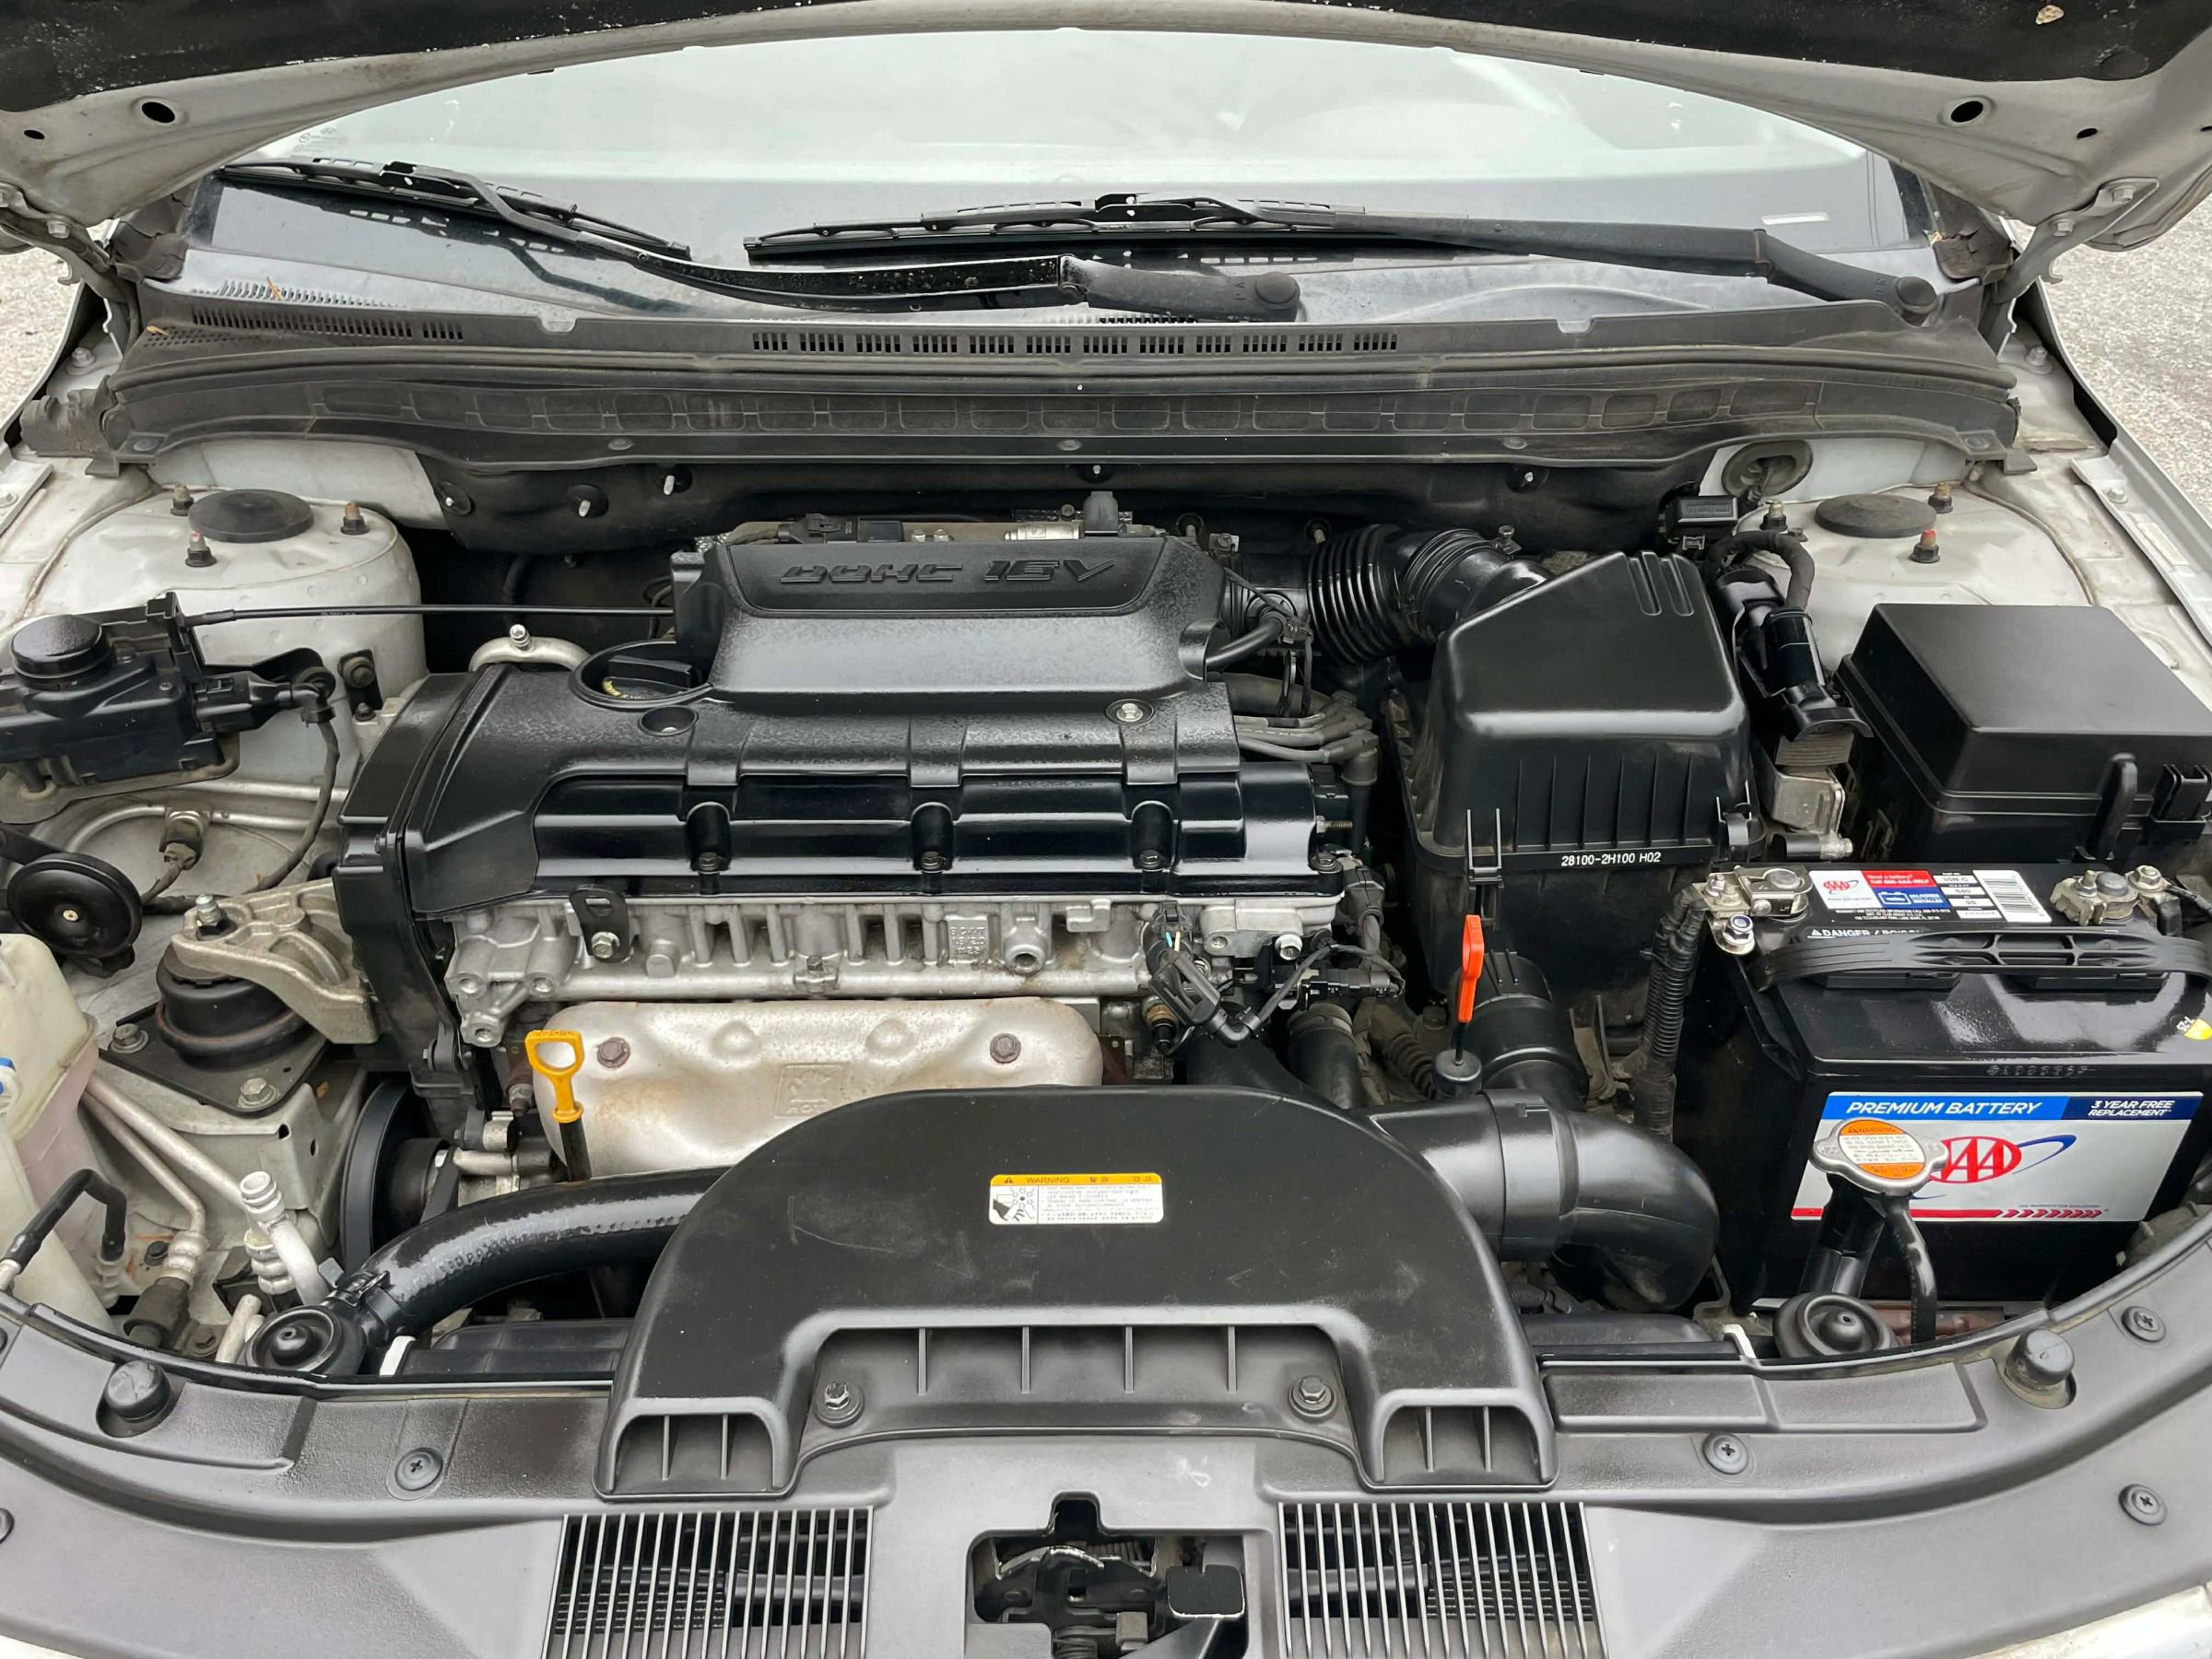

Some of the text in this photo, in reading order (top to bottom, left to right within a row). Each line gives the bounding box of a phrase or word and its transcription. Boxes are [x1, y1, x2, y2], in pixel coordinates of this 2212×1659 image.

[781, 559, 1114, 583] DOHC 16V
[1560, 852, 1662, 866] 28100-2H100 H02
[1846, 1101, 2042, 1114] PREMIUM BATTERY
[2091, 1100, 2175, 1109] 3 YEAR FREE
[1026, 1176, 1070, 1184] WARNING
